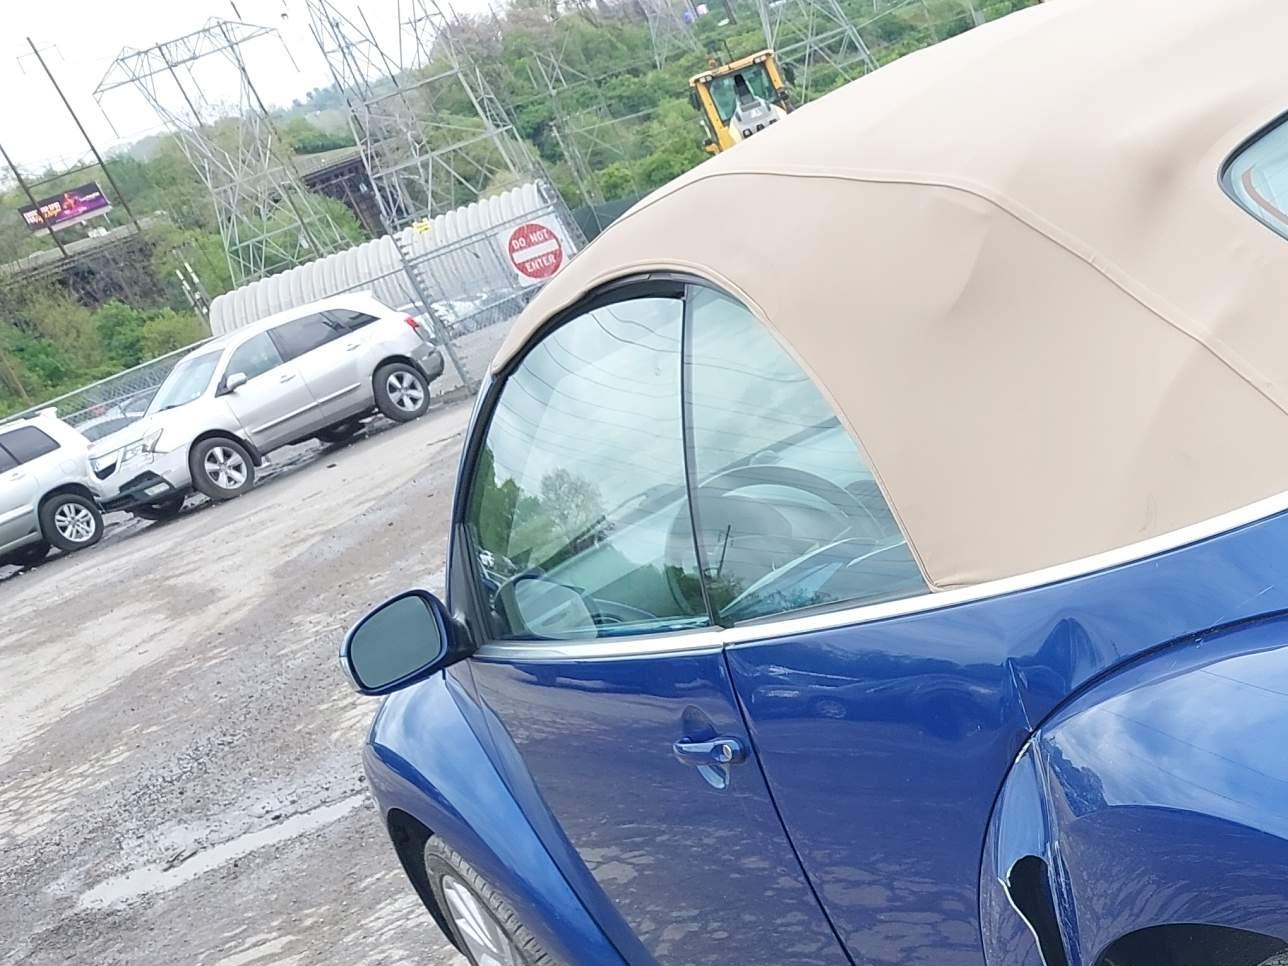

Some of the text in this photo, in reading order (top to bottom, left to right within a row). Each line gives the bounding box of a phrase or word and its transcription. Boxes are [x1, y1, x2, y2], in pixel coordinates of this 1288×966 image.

[512, 228, 549, 250] DO NOT
[525, 255, 556, 273] ENTER
